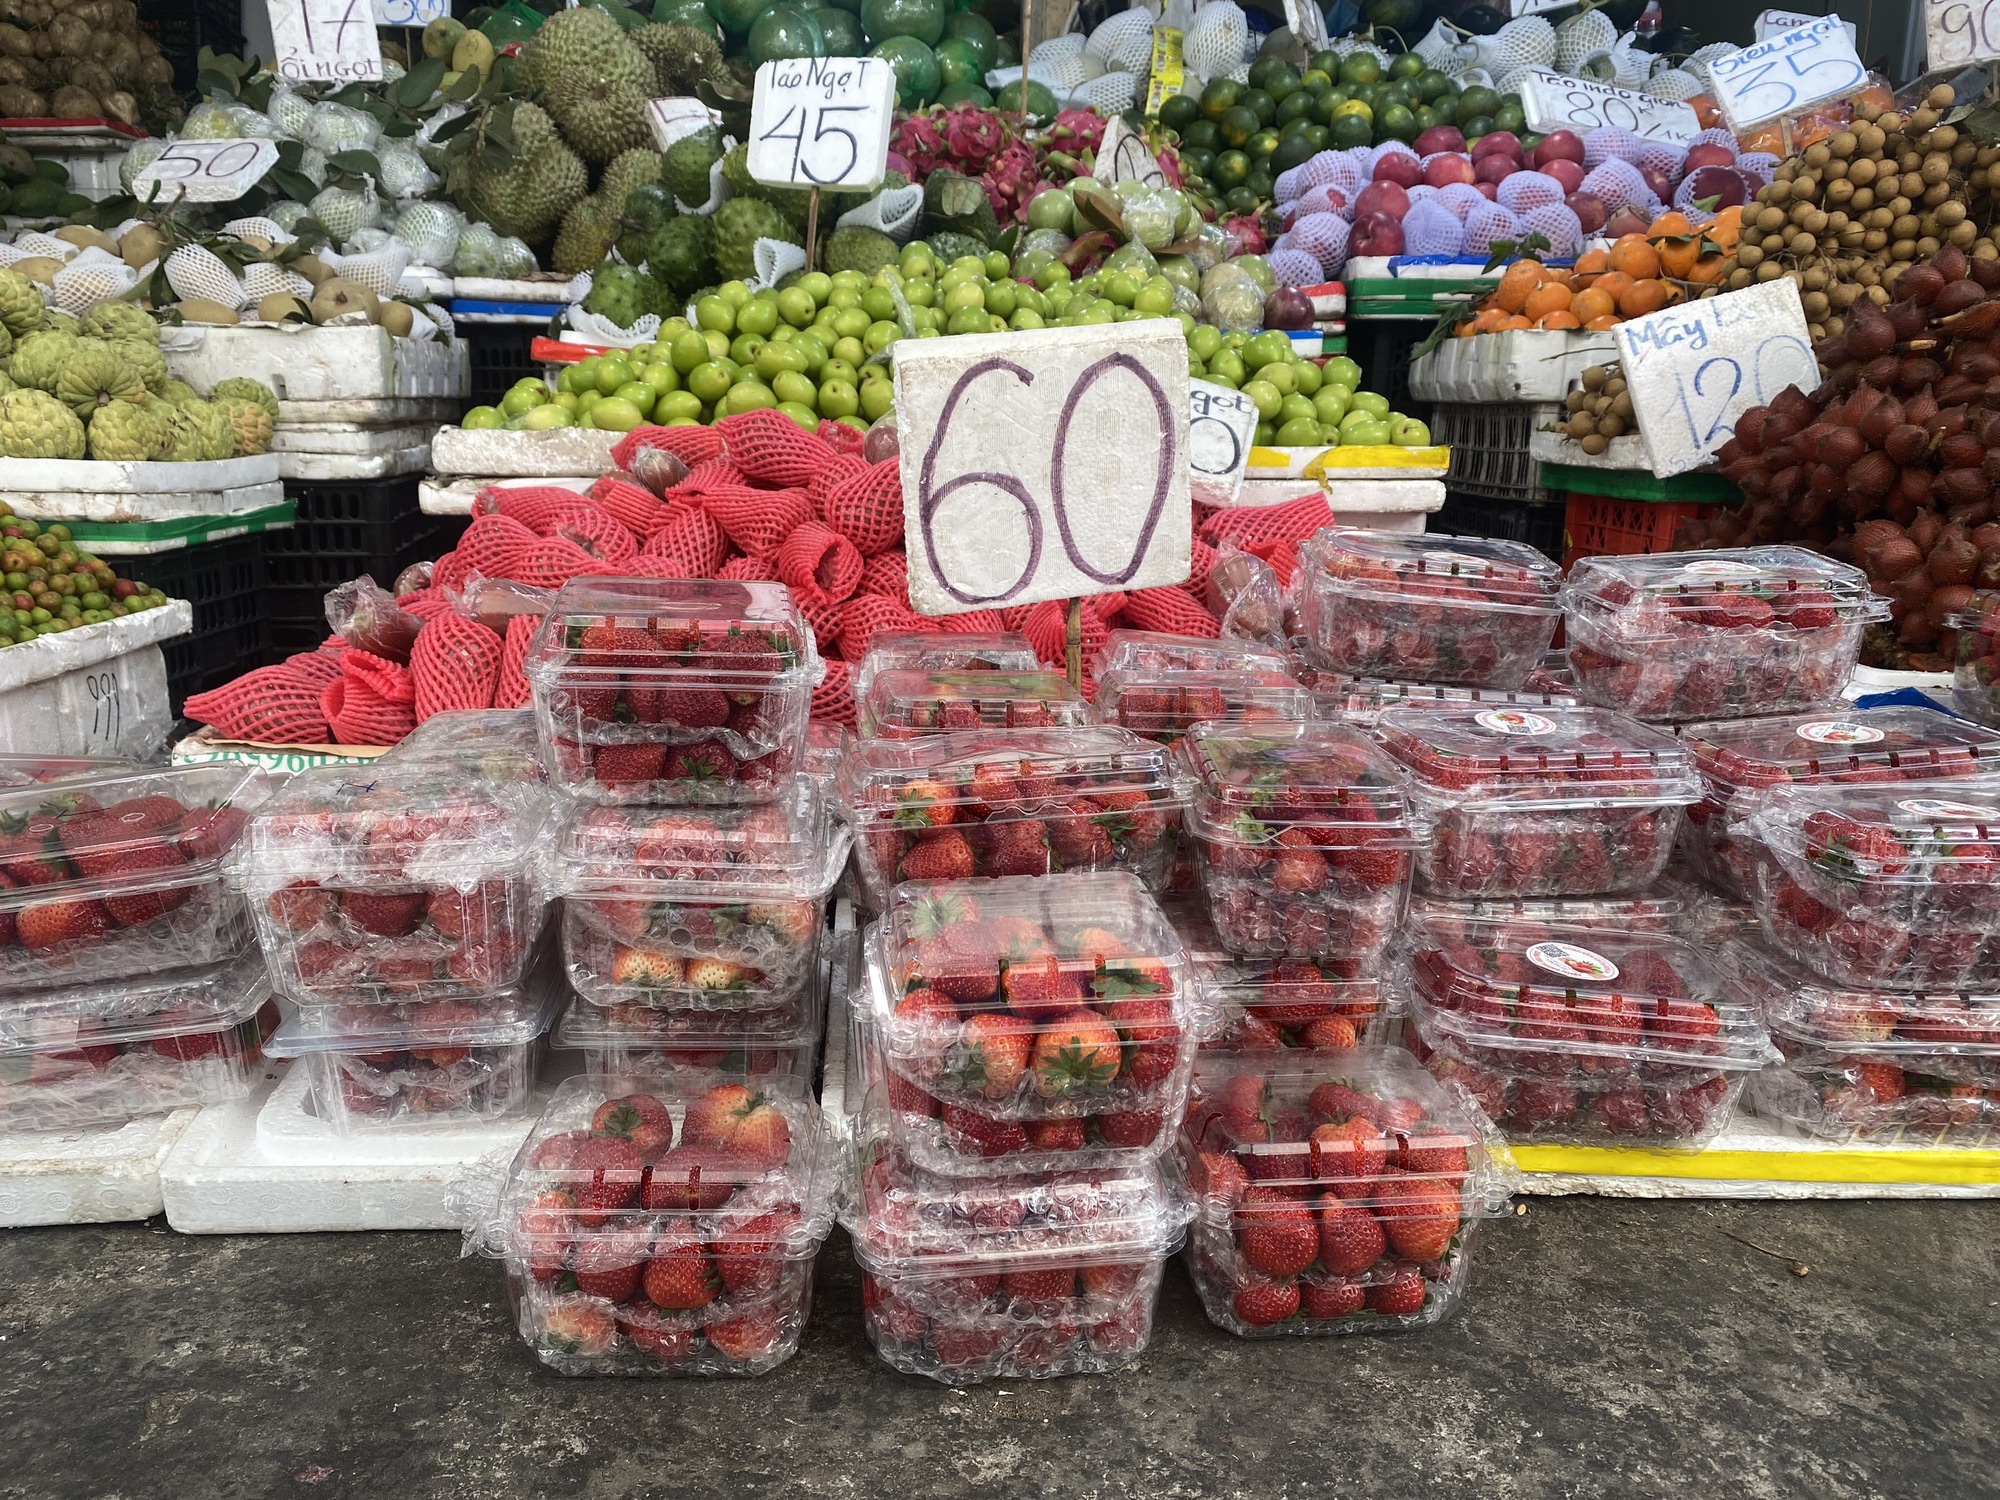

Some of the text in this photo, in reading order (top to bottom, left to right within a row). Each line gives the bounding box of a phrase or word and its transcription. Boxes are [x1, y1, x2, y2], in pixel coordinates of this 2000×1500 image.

[1724, 46, 1863, 124] 35
[144, 141, 260, 180] 50
[758, 104, 870, 184] 45
[1663, 334, 1822, 450] 120
[918, 351, 1177, 606] 60
